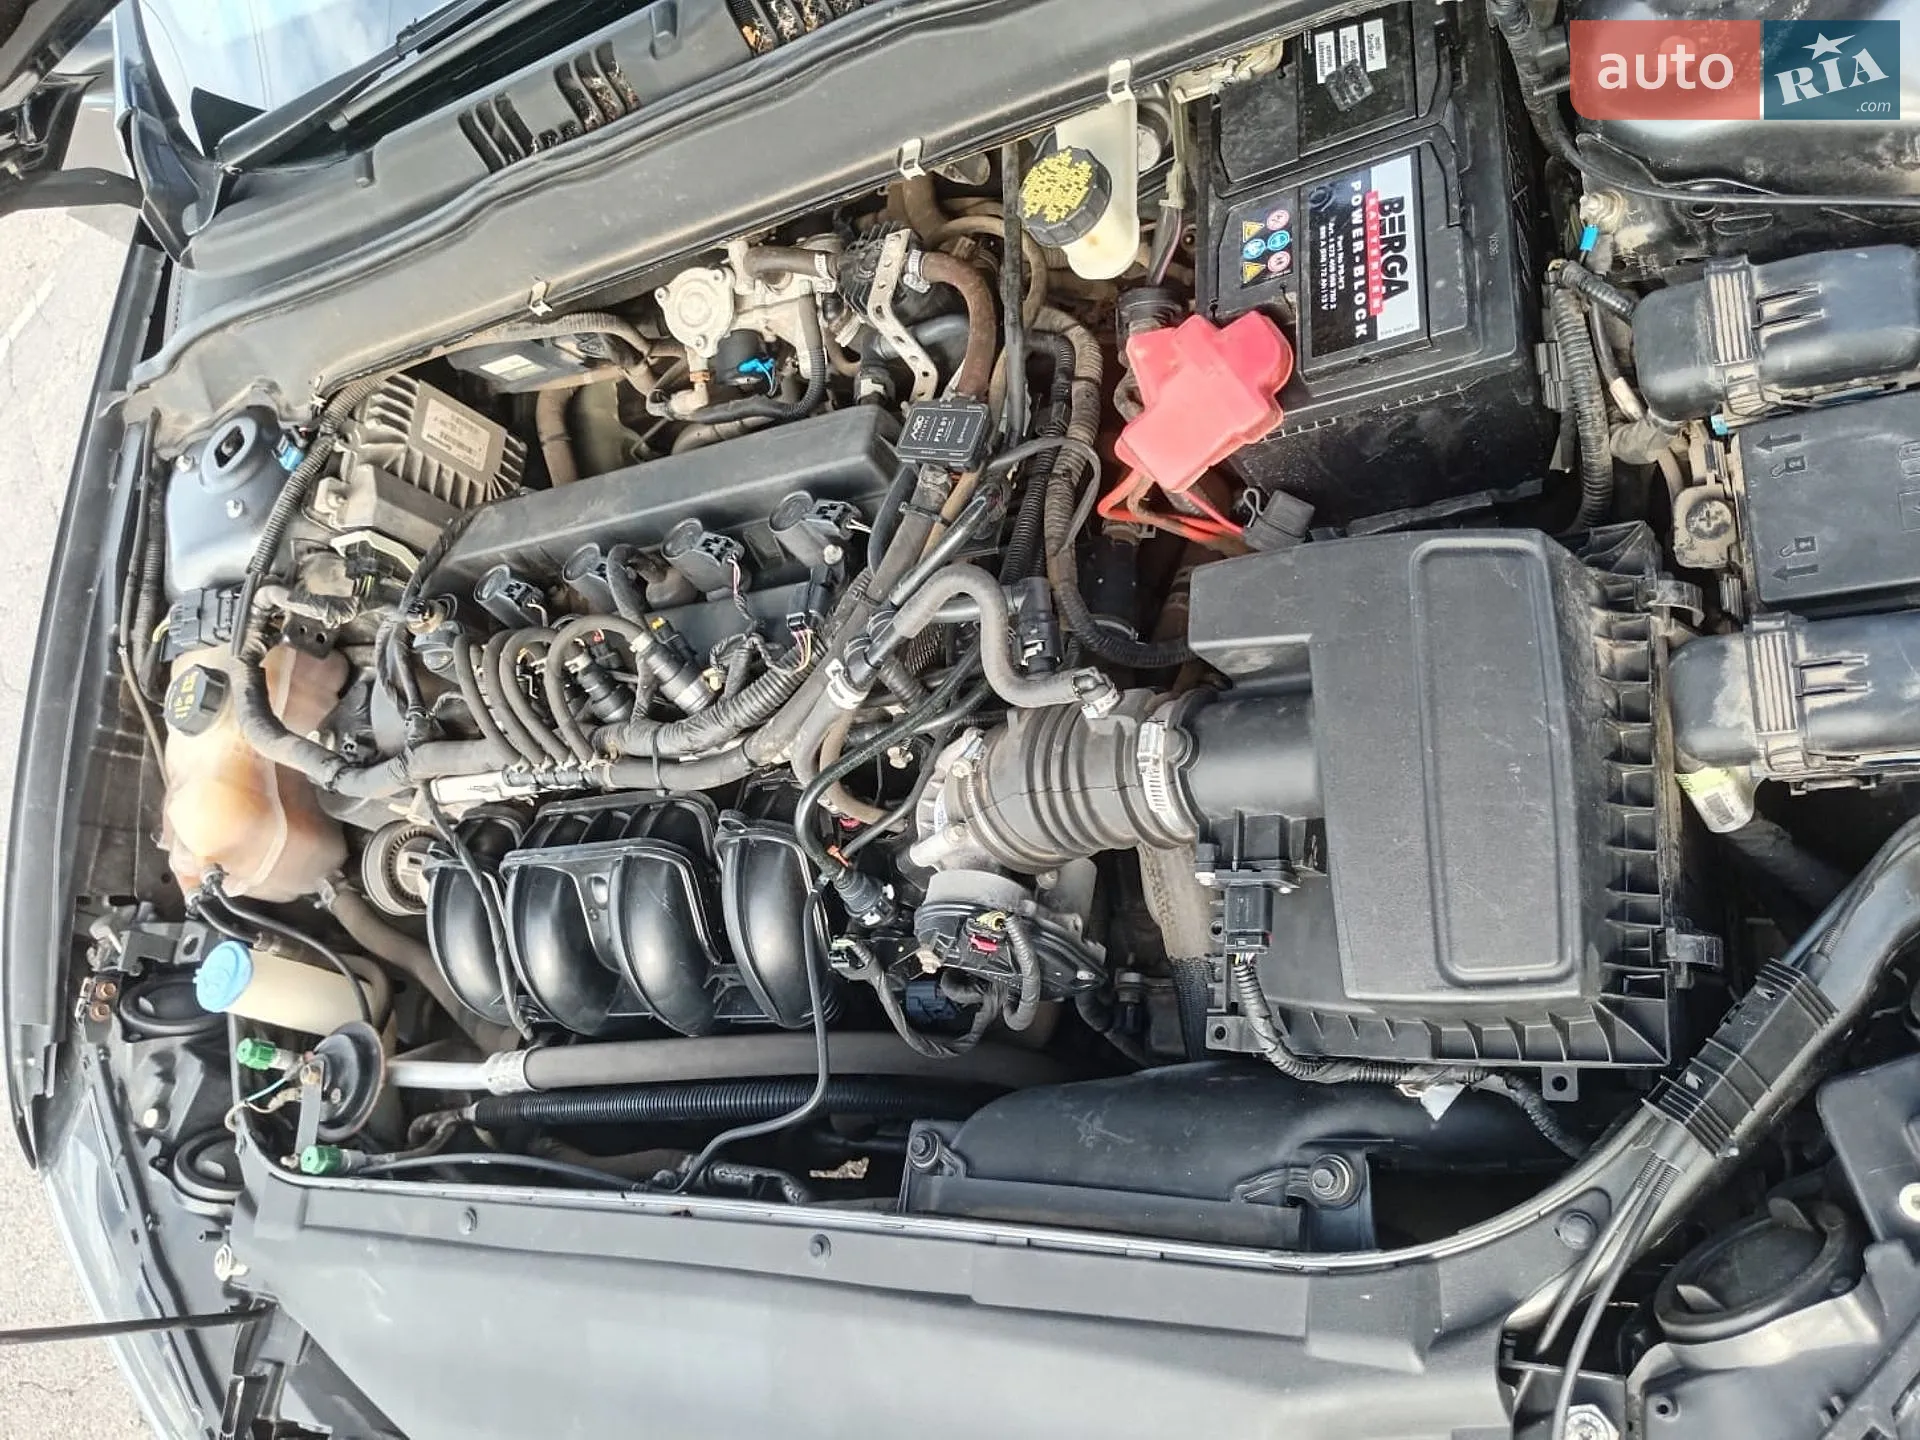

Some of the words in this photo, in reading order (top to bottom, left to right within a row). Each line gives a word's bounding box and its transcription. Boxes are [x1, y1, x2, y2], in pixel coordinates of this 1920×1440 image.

[1351, 180, 1368, 338] POWER-BLOCK
[1367, 195, 1382, 309] BATTERIEN
[1379, 196, 1409, 302] BERGA
